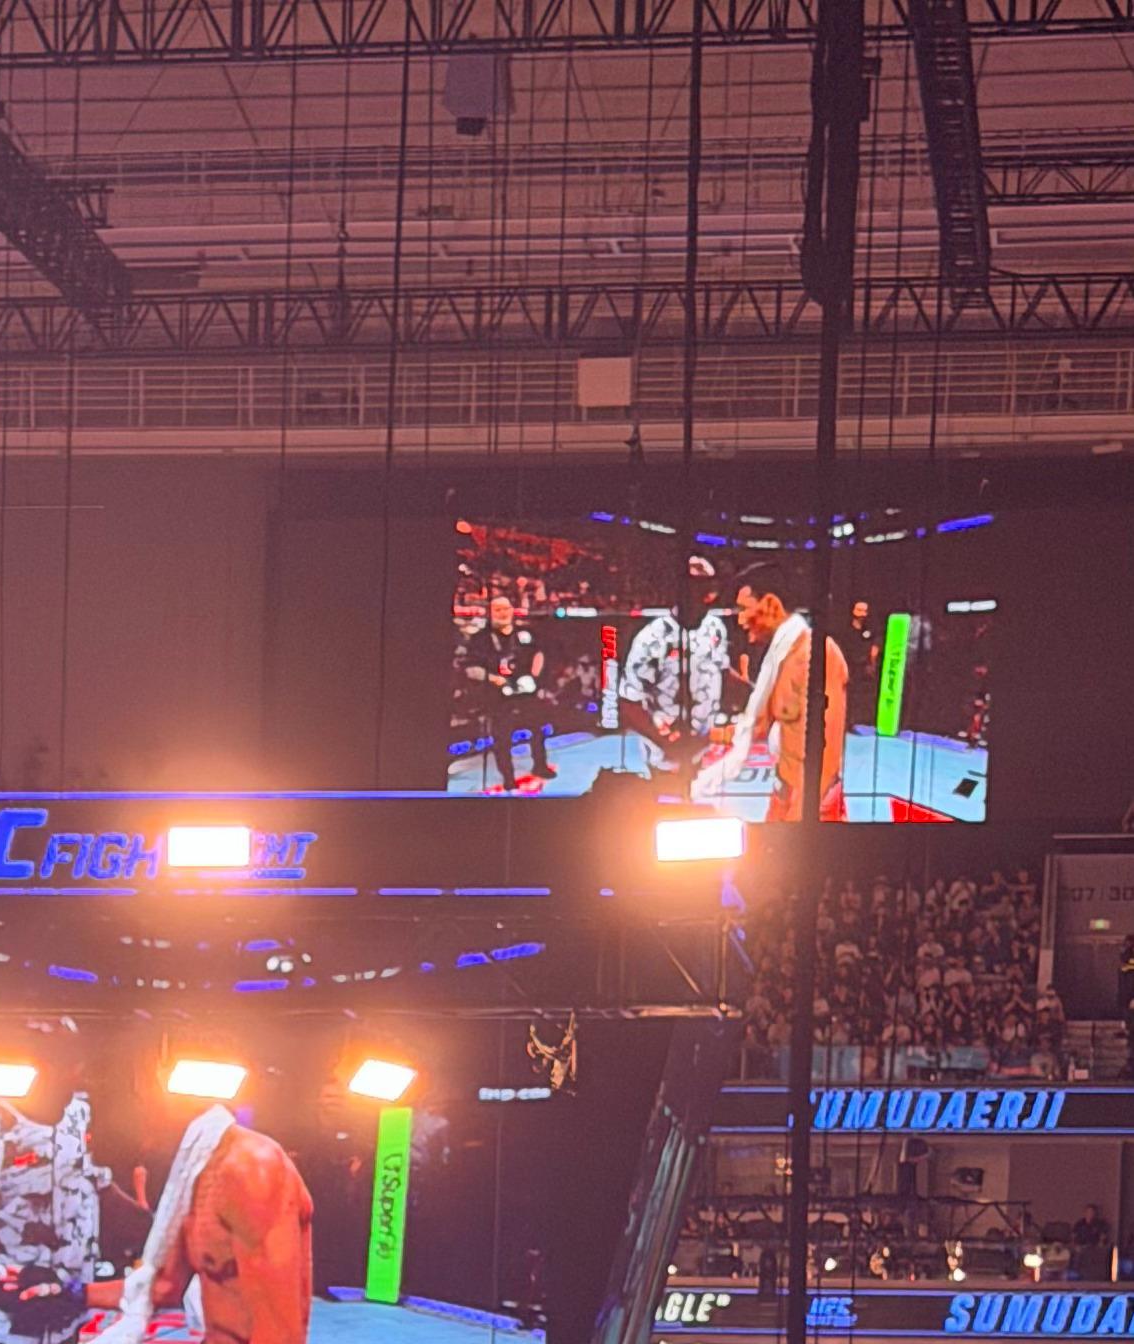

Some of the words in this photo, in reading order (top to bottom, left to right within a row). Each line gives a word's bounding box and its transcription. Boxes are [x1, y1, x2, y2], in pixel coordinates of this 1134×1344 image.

[40, 832, 163, 879] FIGH
[809, 1090, 1066, 1130] UMUDAERJI
[945, 1293, 1134, 1334] SUMUDA
